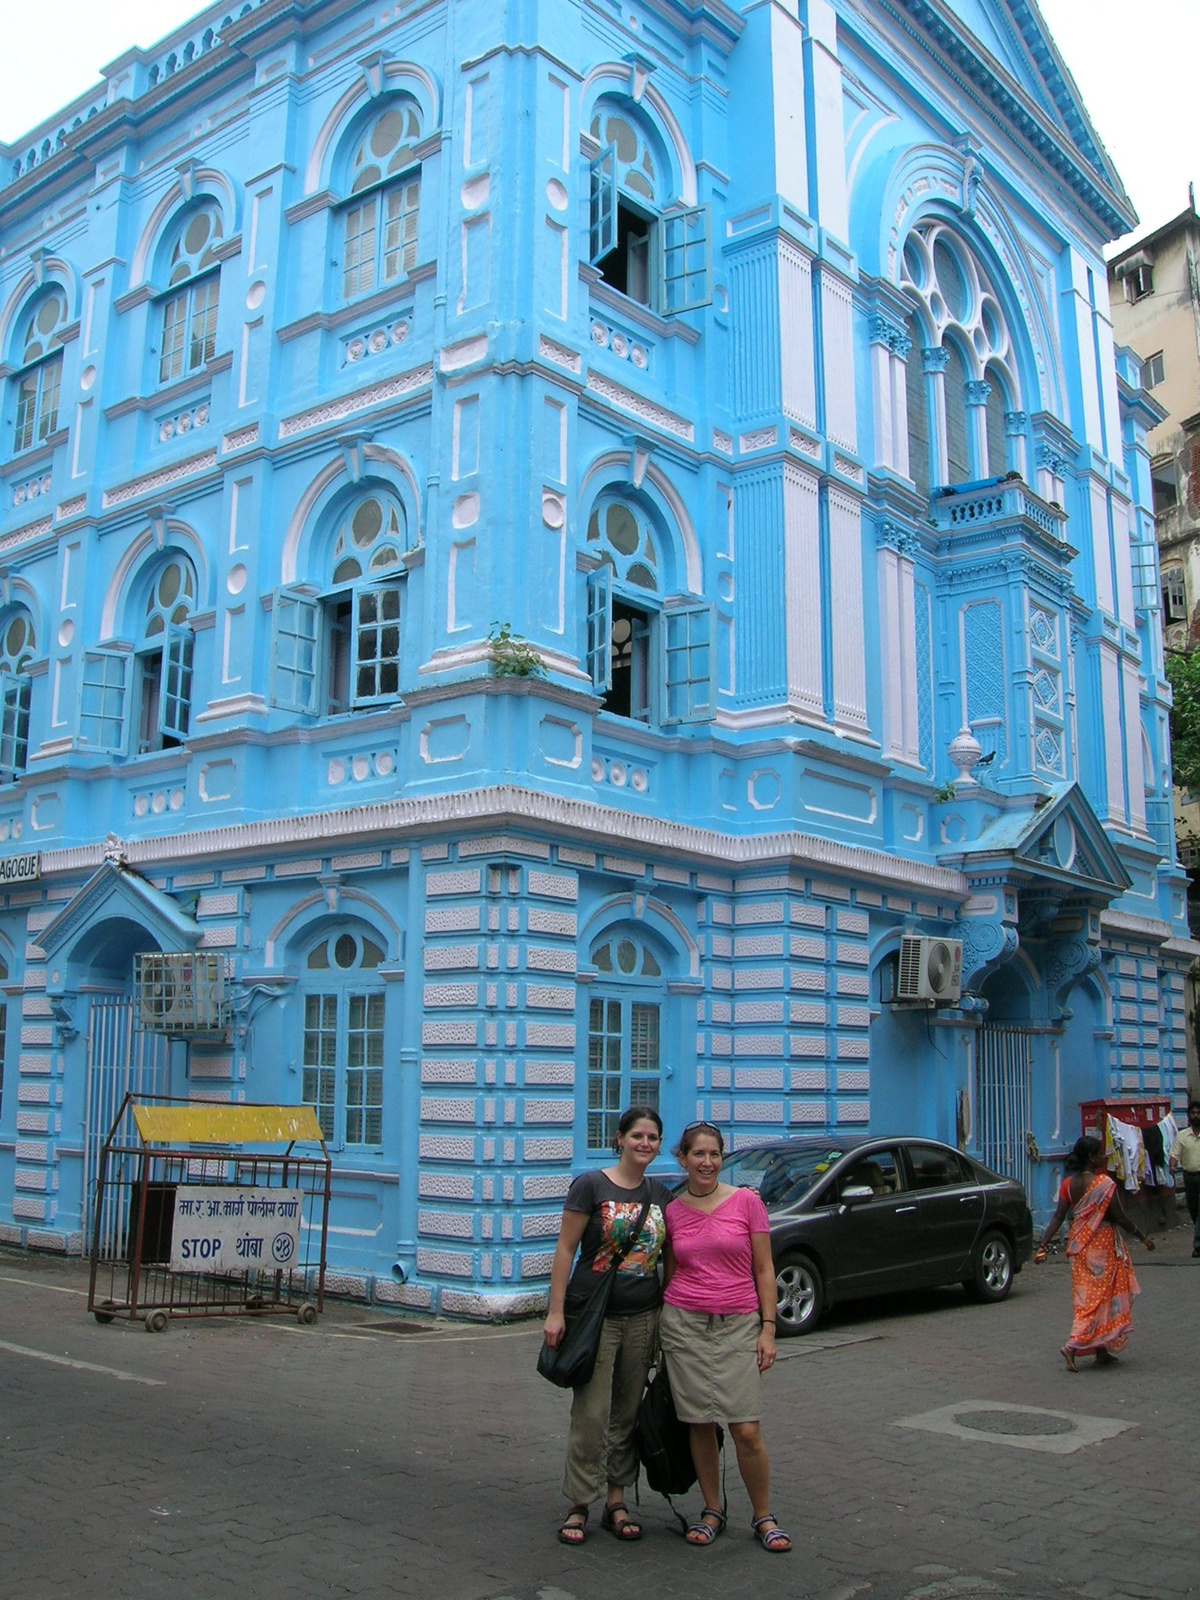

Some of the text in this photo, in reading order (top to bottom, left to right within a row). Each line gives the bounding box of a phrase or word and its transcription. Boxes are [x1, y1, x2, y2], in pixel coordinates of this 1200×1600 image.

[247, 1195, 277, 1218] पोलीस
[278, 1196, 299, 1218] ठाणे
[181, 1238, 222, 1259] STOP
[235, 1232, 264, 1259] थांबा
